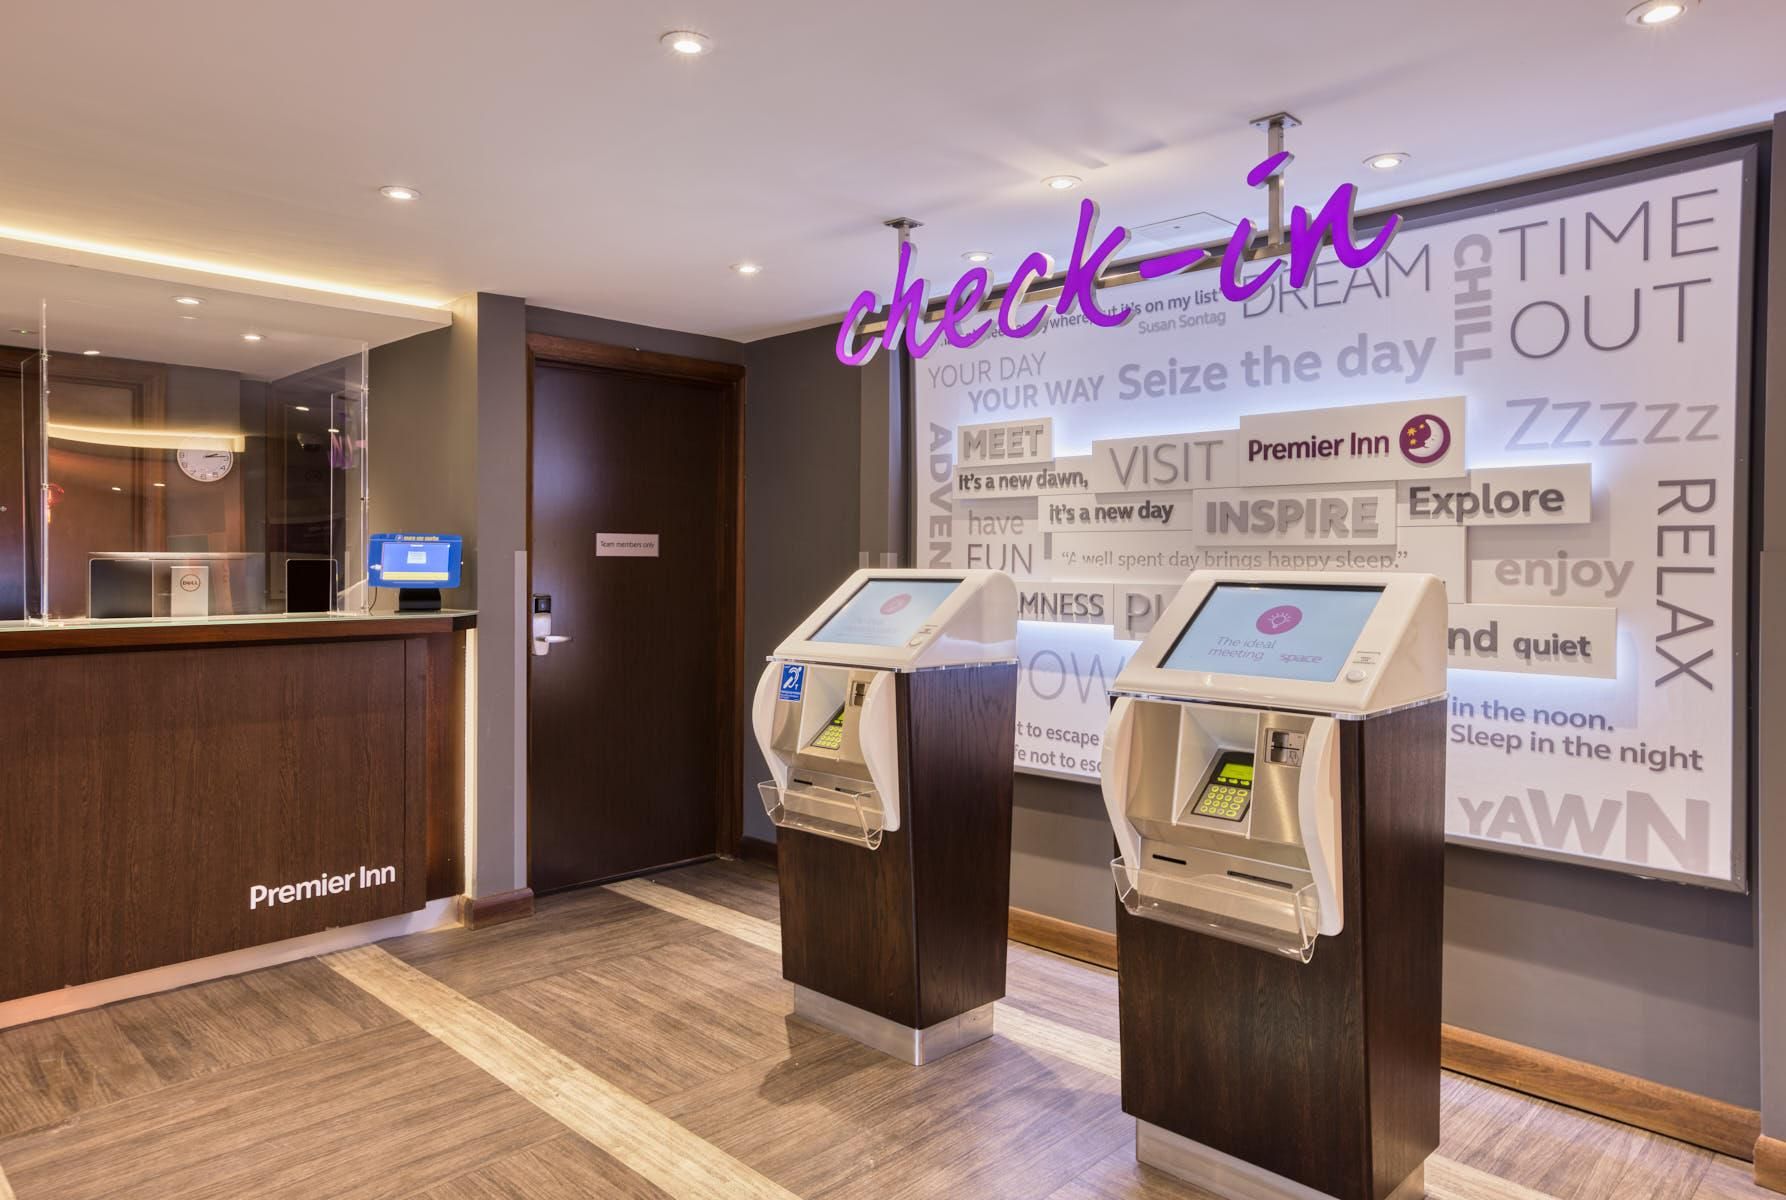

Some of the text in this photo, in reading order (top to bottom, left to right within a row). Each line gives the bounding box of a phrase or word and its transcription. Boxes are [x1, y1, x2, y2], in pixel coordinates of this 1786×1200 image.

[1498, 189, 1718, 282] TIME
[835, 150, 1403, 366] check-in
[1243, 244, 1430, 319] DREAM
[1145, 300, 1164, 313] on
[1167, 293, 1191, 312] my
[1454, 233, 1492, 376] CHILL
[1510, 278, 1711, 359] OUT
[1138, 311, 1226, 335] Susan Sontag
[928, 352, 1046, 389] YOUR DAY
[1118, 332, 1437, 400] Seize the day
[968, 375, 1104, 414] YOUR WAY
[963, 424, 1044, 460] MEET
[1248, 432, 1389, 463] Premier Inn
[958, 468, 1088, 491] It's a new dawn,
[1109, 440, 1223, 486] VISIT
[1049, 500, 1174, 524] it's a new day
[1206, 497, 1380, 538] INSPIRE
[1409, 483, 1565, 523] Explore
[968, 510, 1024, 536] have
[967, 544, 1032, 574] FUN
[1082, 551, 1113, 567] well
[1118, 551, 1164, 575] spent
[1169, 551, 1201, 575] day
[1204, 551, 1262, 572] brings
[1268, 551, 1330, 571] happy
[1495, 551, 1634, 598] enjoy
[1655, 479, 1716, 691] RELAX
[1018, 592, 1104, 618] MNESS
[1208, 648, 1323, 664] meeting space
[1217, 636, 1278, 649] The ideal
[1448, 621, 1591, 660] nd quiet
[1452, 698, 1614, 732] in the noon.
[1027, 723, 1042, 738] to
[1046, 728, 1099, 748] escape
[1450, 724, 1703, 772] Sleep in the night
[1030, 751, 1056, 766] not
[1060, 753, 1075, 768] to
[1457, 789, 1710, 875] YAWN
[250, 865, 396, 910] Premier Inn
